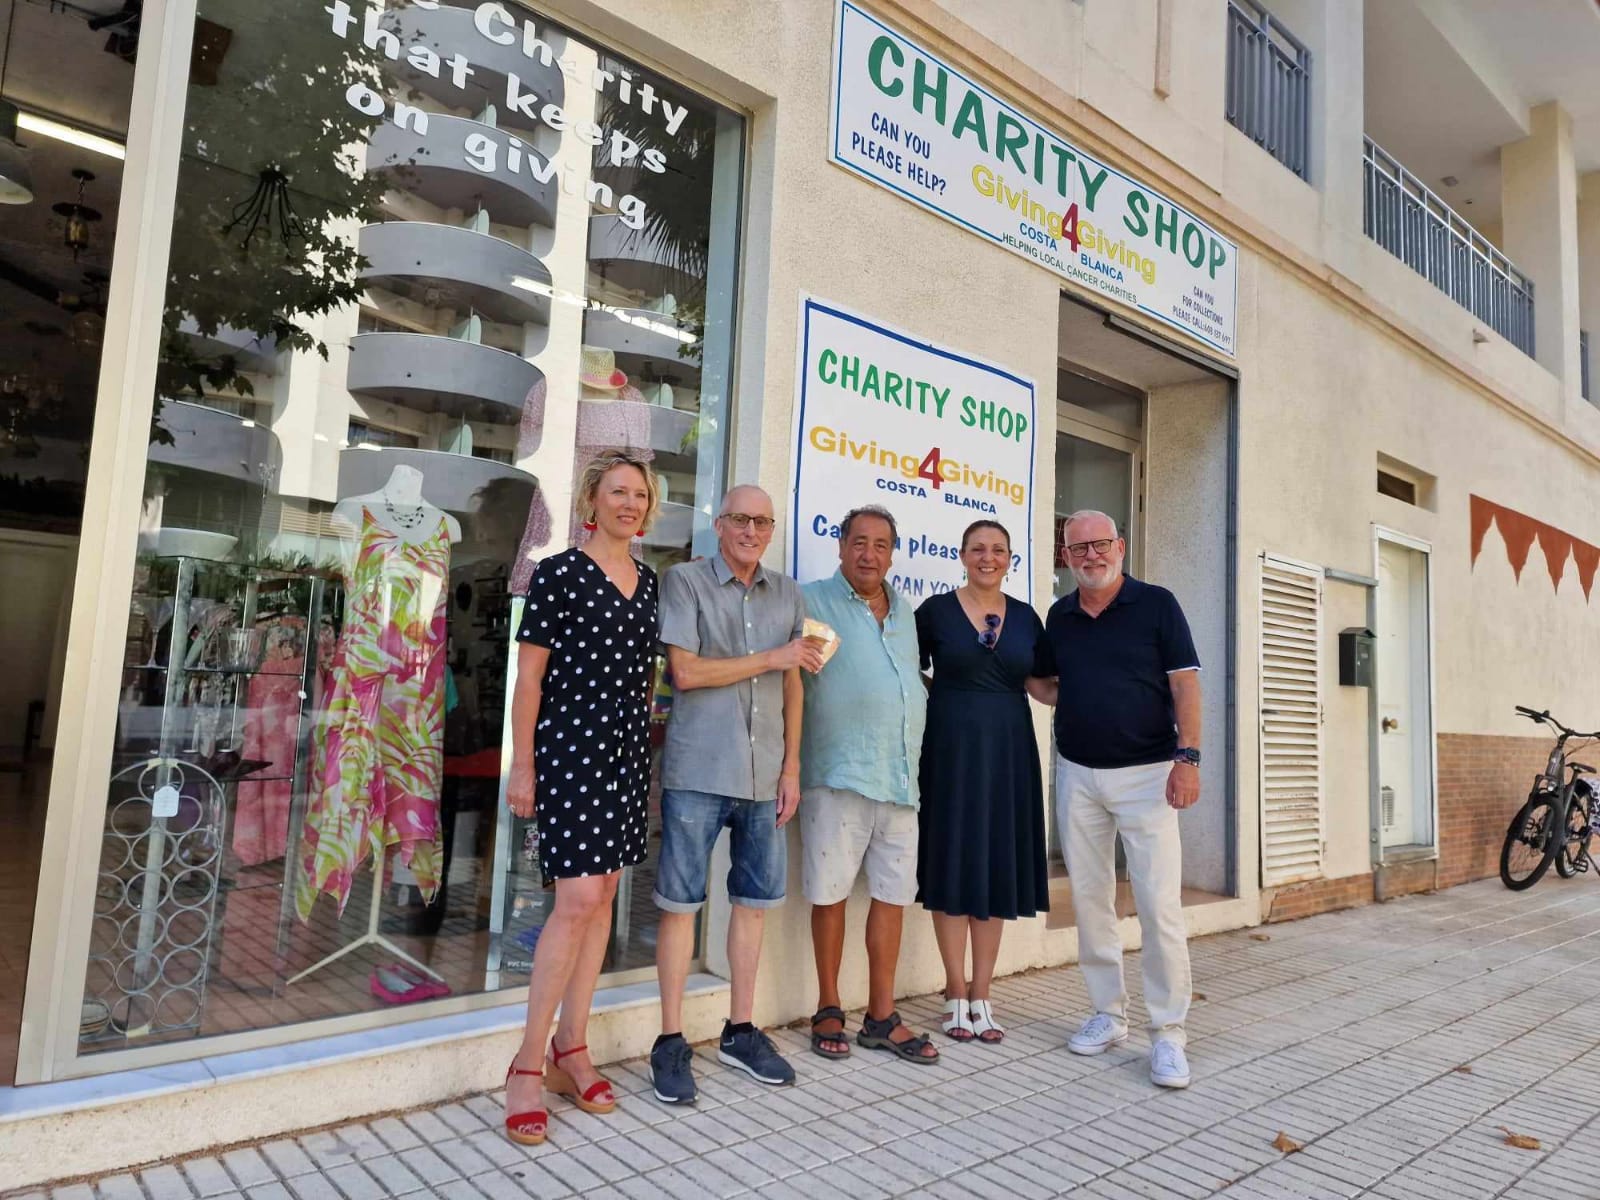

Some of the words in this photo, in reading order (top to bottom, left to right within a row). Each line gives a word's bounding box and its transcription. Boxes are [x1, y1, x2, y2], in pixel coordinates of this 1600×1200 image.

[325, 0, 474, 90] that
[507, 73, 667, 174] keeps
[474, 2, 688, 136] Charity
[346, 83, 429, 136] on
[464, 133, 647, 230] giving
[852, 132, 902, 173] PLEASE
[908, 162, 946, 195] HELP?
[868, 35, 1108, 212] CHARITY
[1123, 190, 1226, 280] SHOP
[871, 112, 899, 142] CAN
[904, 130, 930, 159] YOU
[1002, 233, 1038, 258] HELPING
[1040, 252, 1065, 271] LOCAL
[1067, 265, 1099, 286] CANCER
[1100, 280, 1137, 304] CHARITIES
[1020, 222, 1058, 251] COSTA
[1080, 253, 1124, 283] BLANCA
[1182, 295, 1192, 307] FOR
[1193, 301, 1223, 325] COLLECTIONS
[818, 349, 950, 418] CHARITY
[959, 395, 1028, 442] SHOP
[876, 478, 927, 498] COSTA
[944, 493, 997, 514] BLANCA
[813, 514, 841, 538] Ca
[908, 534, 958, 558] pleas
[892, 574, 923, 596] CAN
